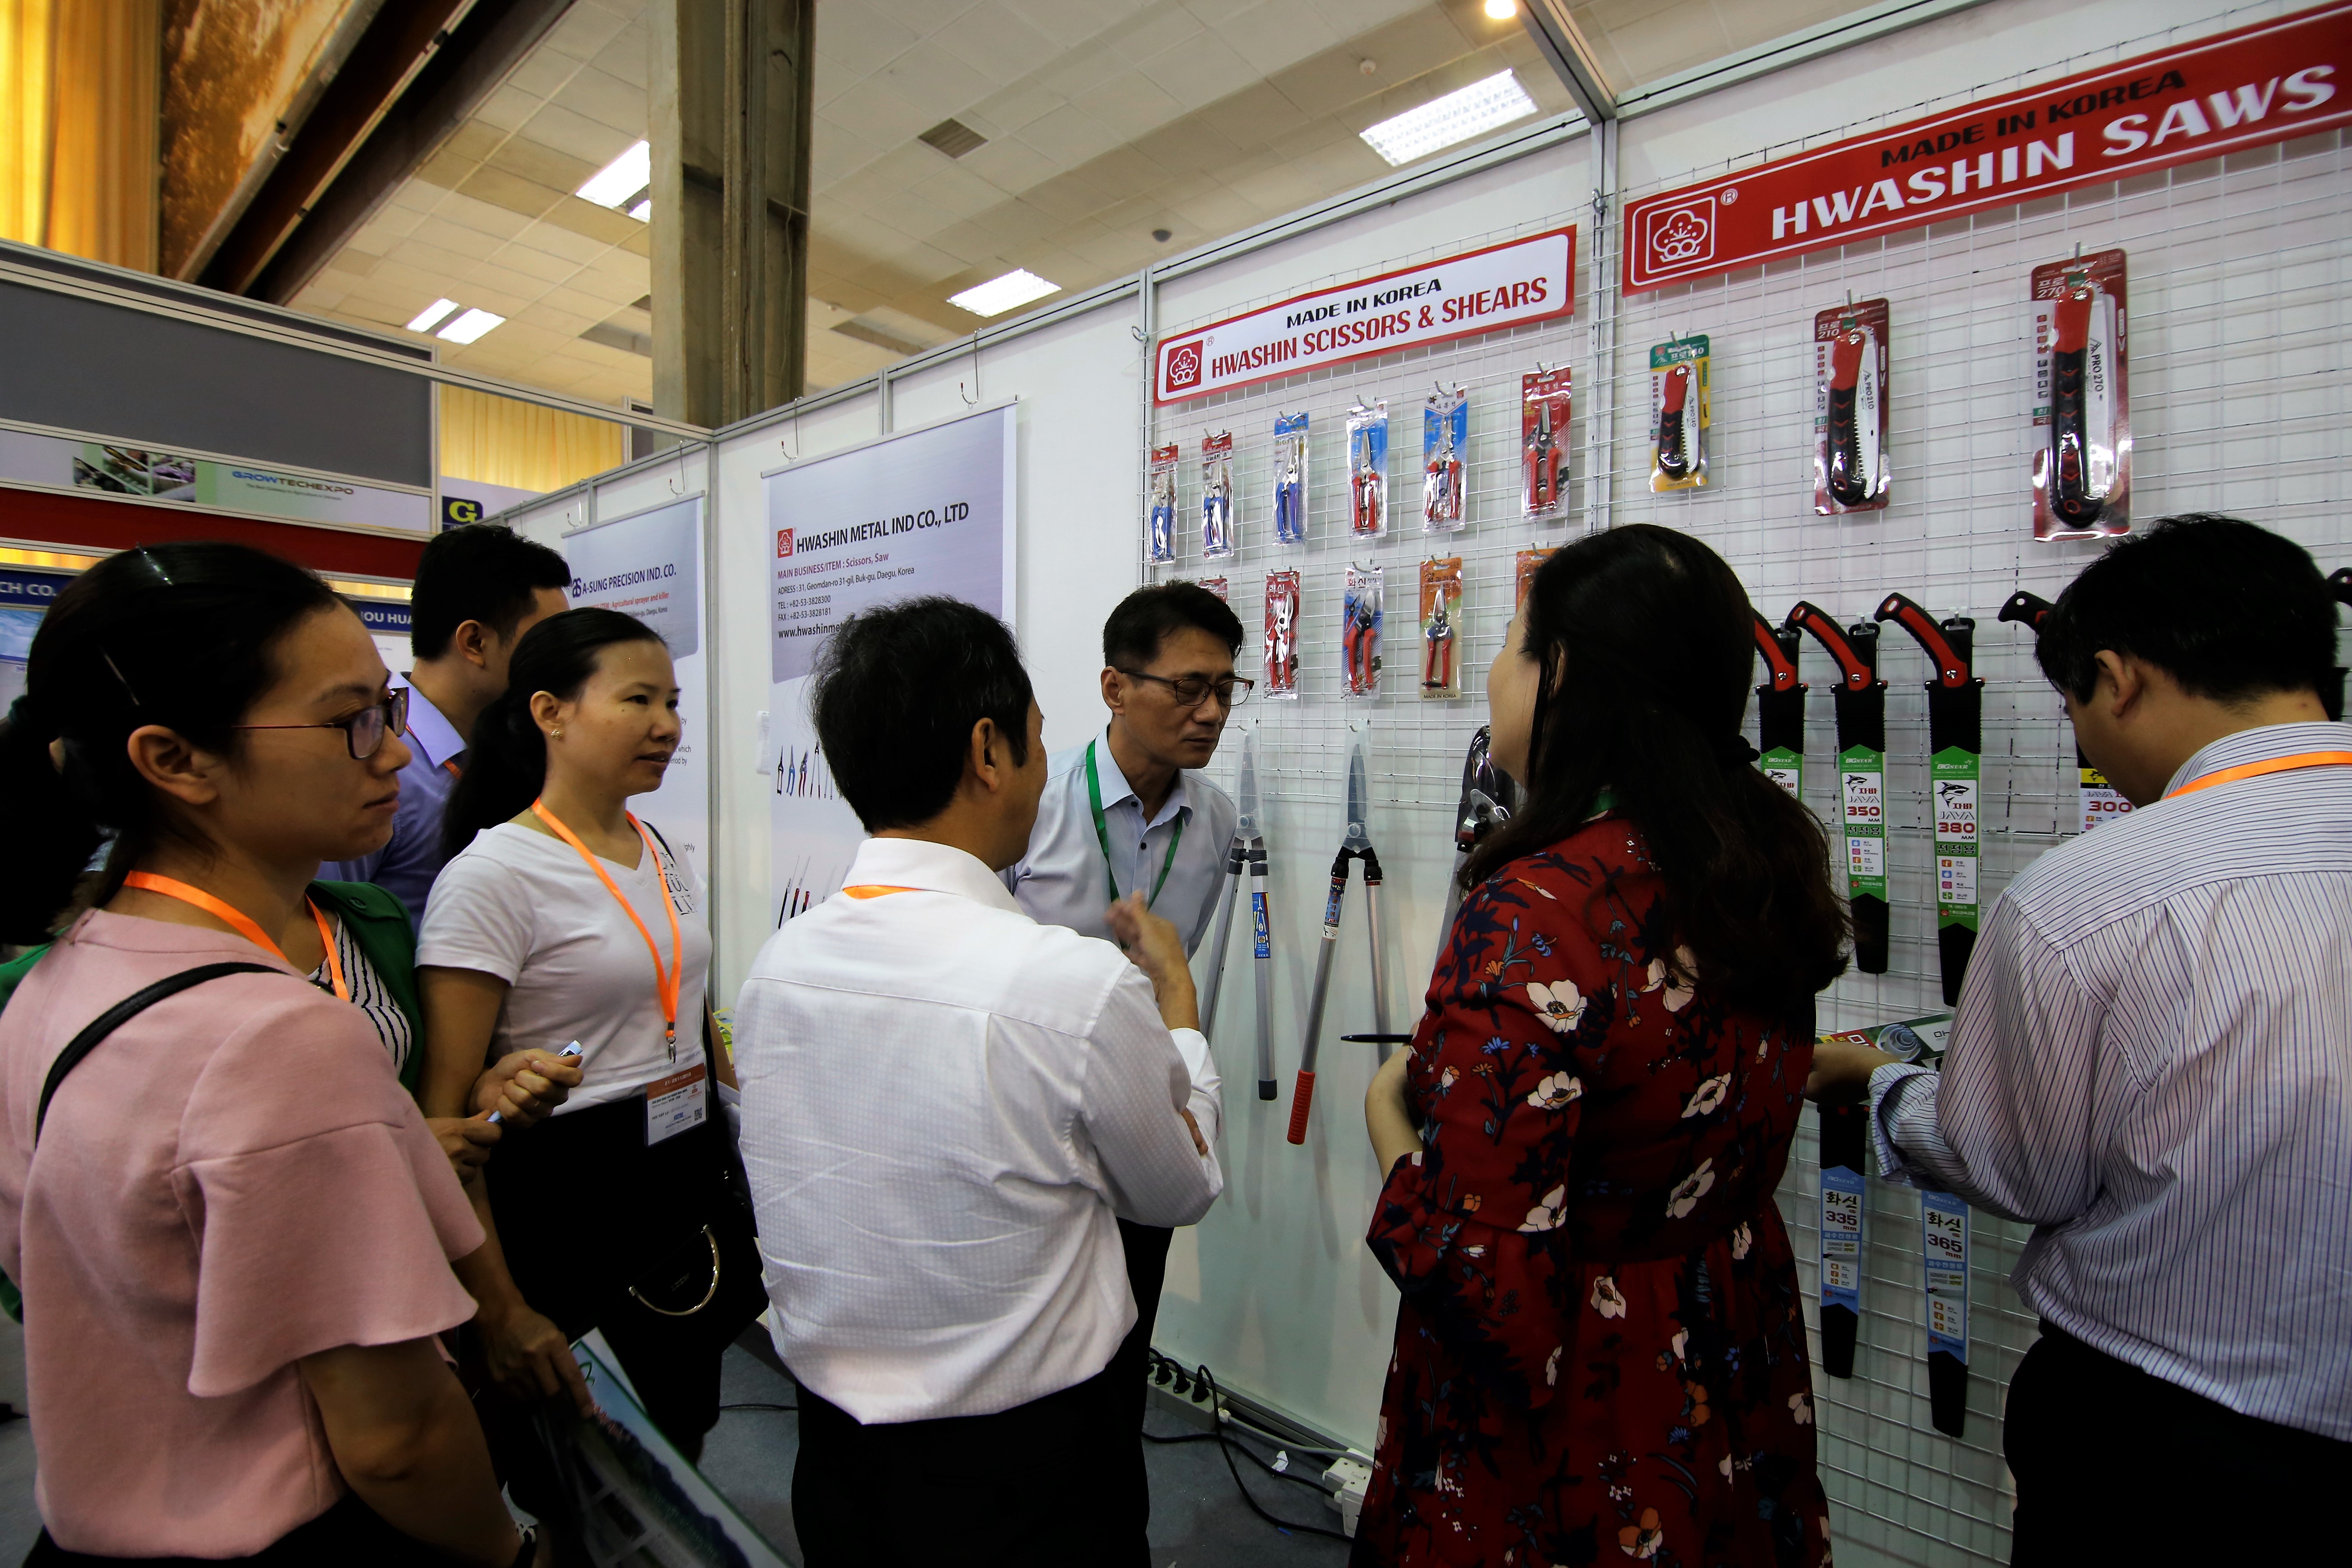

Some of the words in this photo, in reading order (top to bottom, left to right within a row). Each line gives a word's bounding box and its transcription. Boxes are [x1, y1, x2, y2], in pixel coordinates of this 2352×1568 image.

[1882, 135, 1981, 169] MADE
[1997, 110, 2036, 137] IN
[2049, 70, 2188, 123] KOREA
[1772, 131, 2074, 240] HWASHIN
[2102, 64, 2336, 156] SAWS
[2037, 276, 2066, 290] 프로
[2036, 286, 2066, 299] 270
[1287, 303, 1340, 329] MADE
[1348, 298, 1367, 314] IN
[1374, 279, 1442, 306] KOREA
[1212, 337, 1298, 378] HWASHIN
[1303, 309, 1410, 356] SCISSORS
[1418, 304, 1435, 328] &
[1442, 277, 1547, 323] SHEARS
[1817, 320, 1841, 332] 프로
[1817, 328, 1840, 340] 210
[232, 471, 355, 495] GROWTECHEXPO
[449, 501, 478, 523] G
[796, 527, 848, 554] HWASHIN
[851, 520, 889, 542] METAL
[892, 514, 915, 534] IND
[917, 510, 942, 529] CO.,
[945, 502, 969, 524] LTD
[778, 569, 793, 579] MAIN
[794, 560, 842, 577] BUSINESS/ITEM
[846, 556, 873, 568] Scissors,
[875, 553, 889, 562] Saw
[582, 578, 607, 594] A-SUNG
[609, 570, 645, 589] PRECISION
[646, 567, 662, 581] IND.
[664, 563, 676, 577] CO.
[778, 585, 796, 595] ADRESS
[807, 580, 839, 591] Geomdan-ro
[855, 573, 876, 583] Buk-gu,
[877, 570, 897, 580] Daegu,
[897, 567, 915, 576] Korea
[1348, 578, 1366, 588] 화신
[26, 583, 58, 597] CO.
[789, 595, 831, 607] +82-53-3828300
[360, 610, 384, 622] OU
[790, 607, 831, 620] +82-53-3828181
[681, 756, 687, 766] by
[1847, 806, 1880, 816] 350
[2088, 800, 2133, 813] 300
[1936, 811, 1975, 820] JAVA
[1938, 822, 1976, 833] 380
[1825, 1191, 1857, 1209] 화신
[1825, 1210, 1857, 1226] 335
[1927, 1211, 1961, 1233] 화신
[1927, 1233, 1963, 1253] 365
[1945, 1251, 1962, 1259] mm
